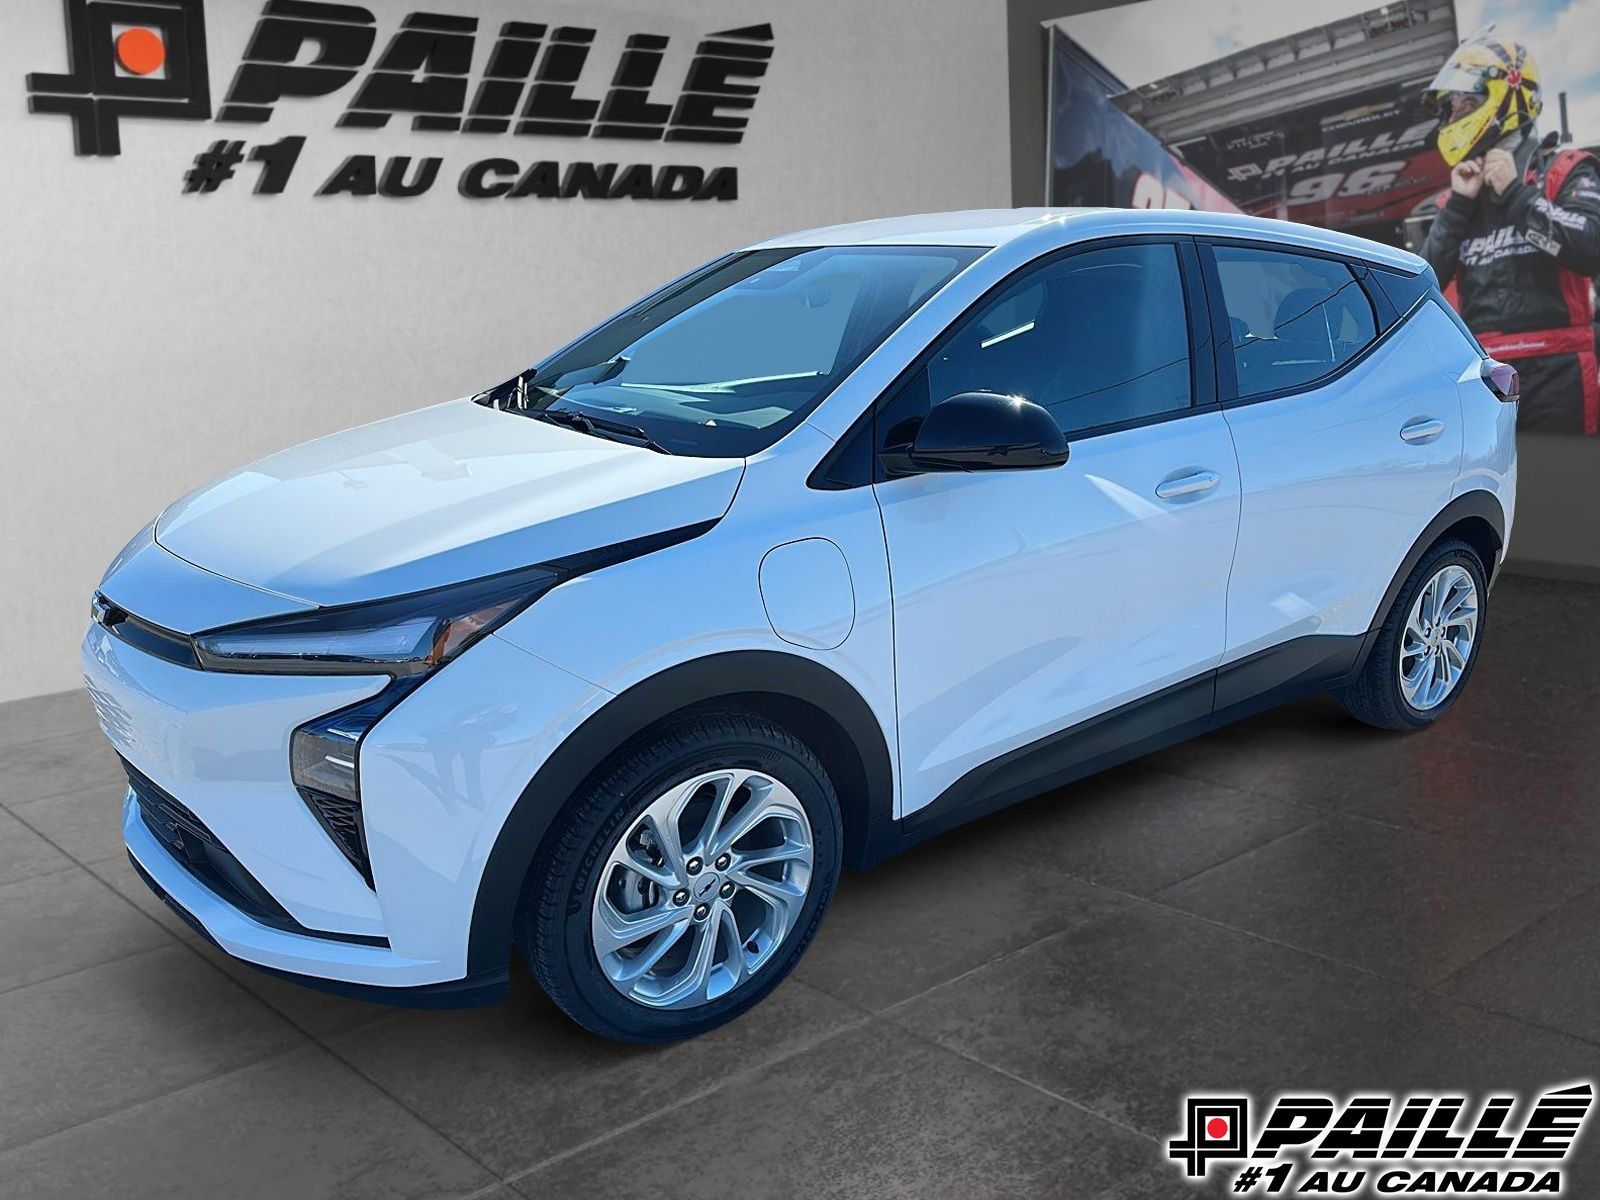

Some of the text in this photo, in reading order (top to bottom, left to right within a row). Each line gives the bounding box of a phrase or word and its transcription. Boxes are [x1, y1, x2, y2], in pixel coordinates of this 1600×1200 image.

[214, 0, 775, 143] PAILLÉ
[182, 135, 739, 202] #1 AU CANADA
[1286, 161, 1407, 206] 96
